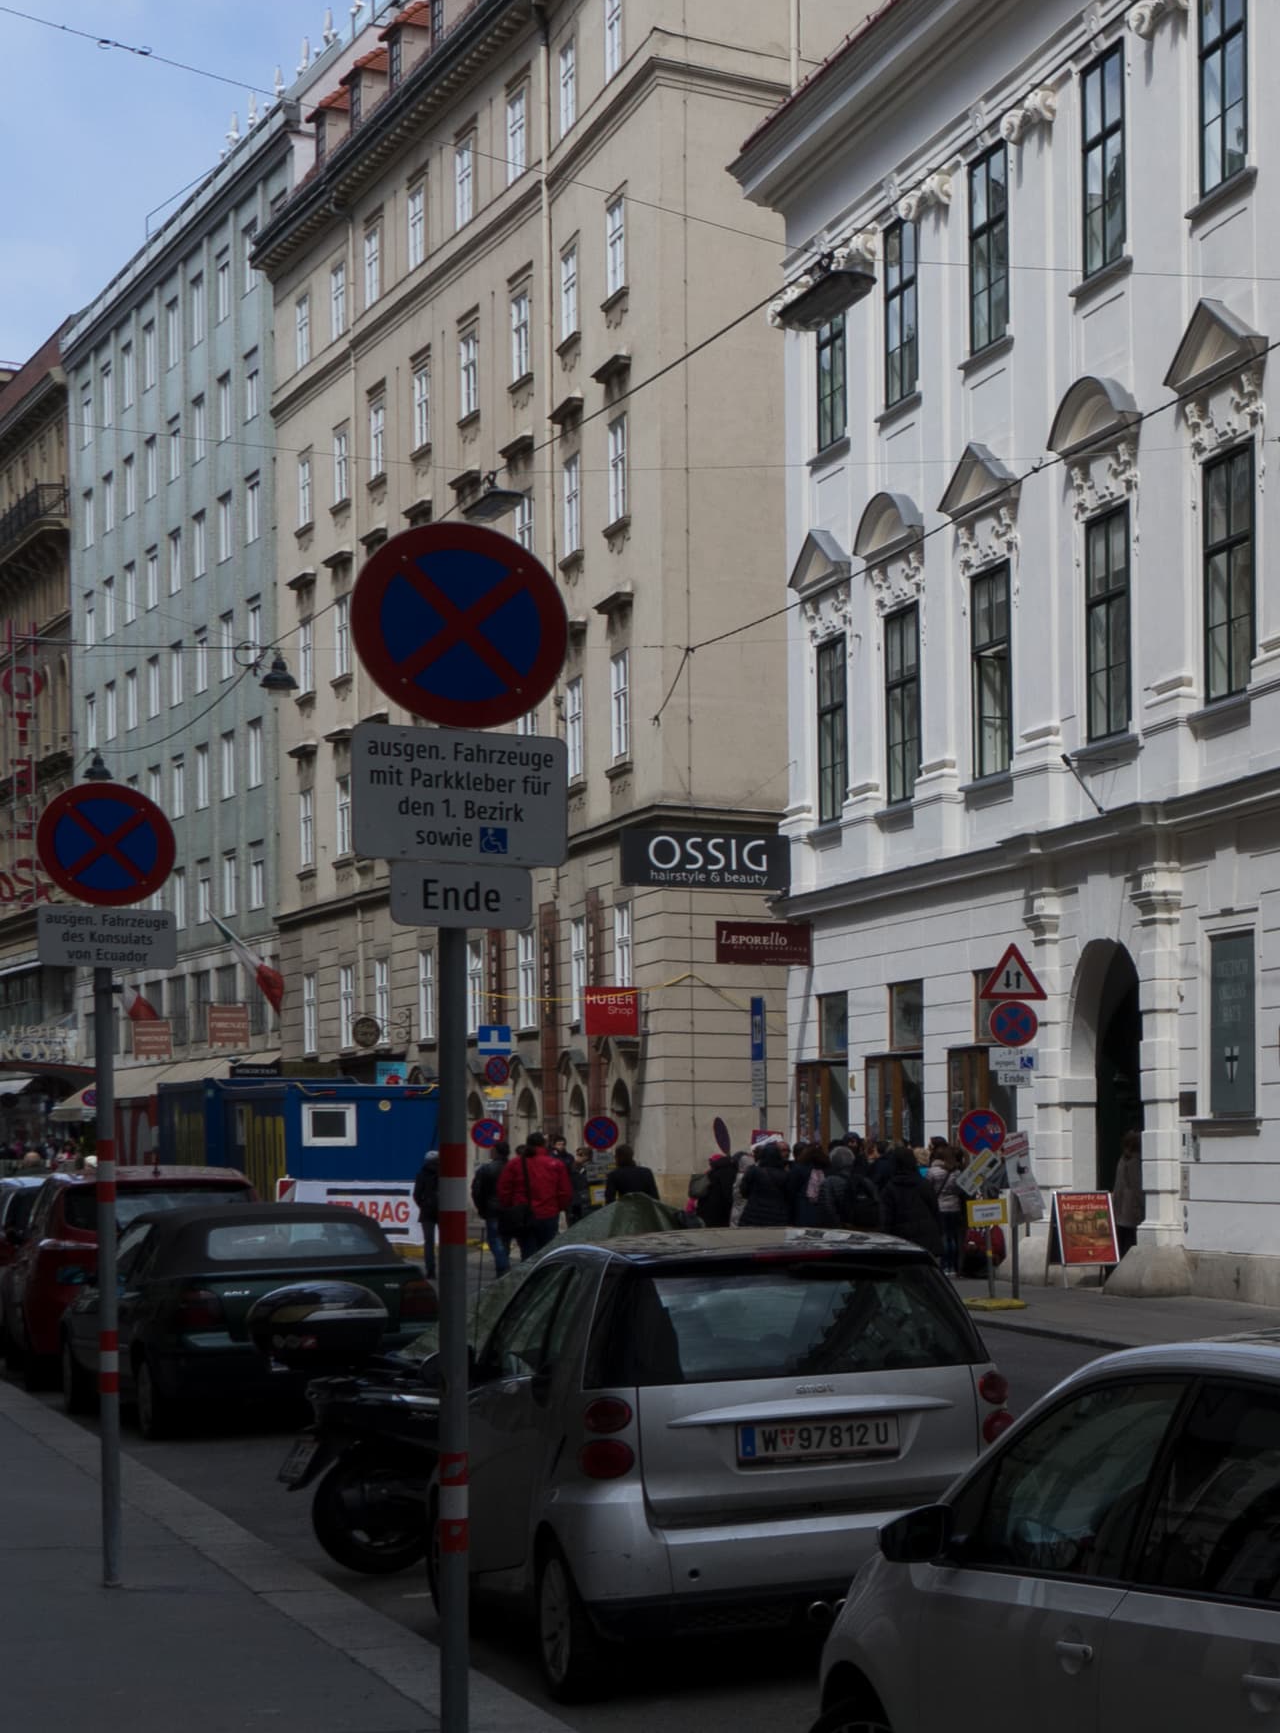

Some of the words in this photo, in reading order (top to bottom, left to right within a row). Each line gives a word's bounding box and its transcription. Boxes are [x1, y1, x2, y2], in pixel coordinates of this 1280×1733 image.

[367, 739, 446, 762] ausgen.
[453, 742, 554, 772] Fahrzeuge
[370, 765, 403, 786] mit
[410, 768, 516, 793] Parkkleber
[521, 775, 552, 797] für
[398, 796, 434, 817] den
[442, 798, 457, 818] 1.
[464, 800, 524, 822] Bezirk
[415, 827, 473, 847] sowie
[648, 835, 768, 871] OSSIG
[650, 869, 706, 884] hairstyle
[710, 871, 720, 883] &
[724, 872, 768, 886] beauty
[422, 878, 501, 912] Ende
[46, 913, 97, 928] ausgen.
[102, 914, 169, 932] Fahrzeuge
[61, 931, 85, 943] des
[89, 932, 153, 945] Konsulats
[67, 950, 91, 960] von
[95, 948, 149, 962] Ecuador
[586, 994, 633, 1005] HUBER
[607, 1005, 634, 1018] Shop
[1004, 1073, 1025, 1083] Ende
[762, 1429, 778, 1452] W
[798, 1424, 869, 1449] 97812
[875, 1421, 889, 1444] U
